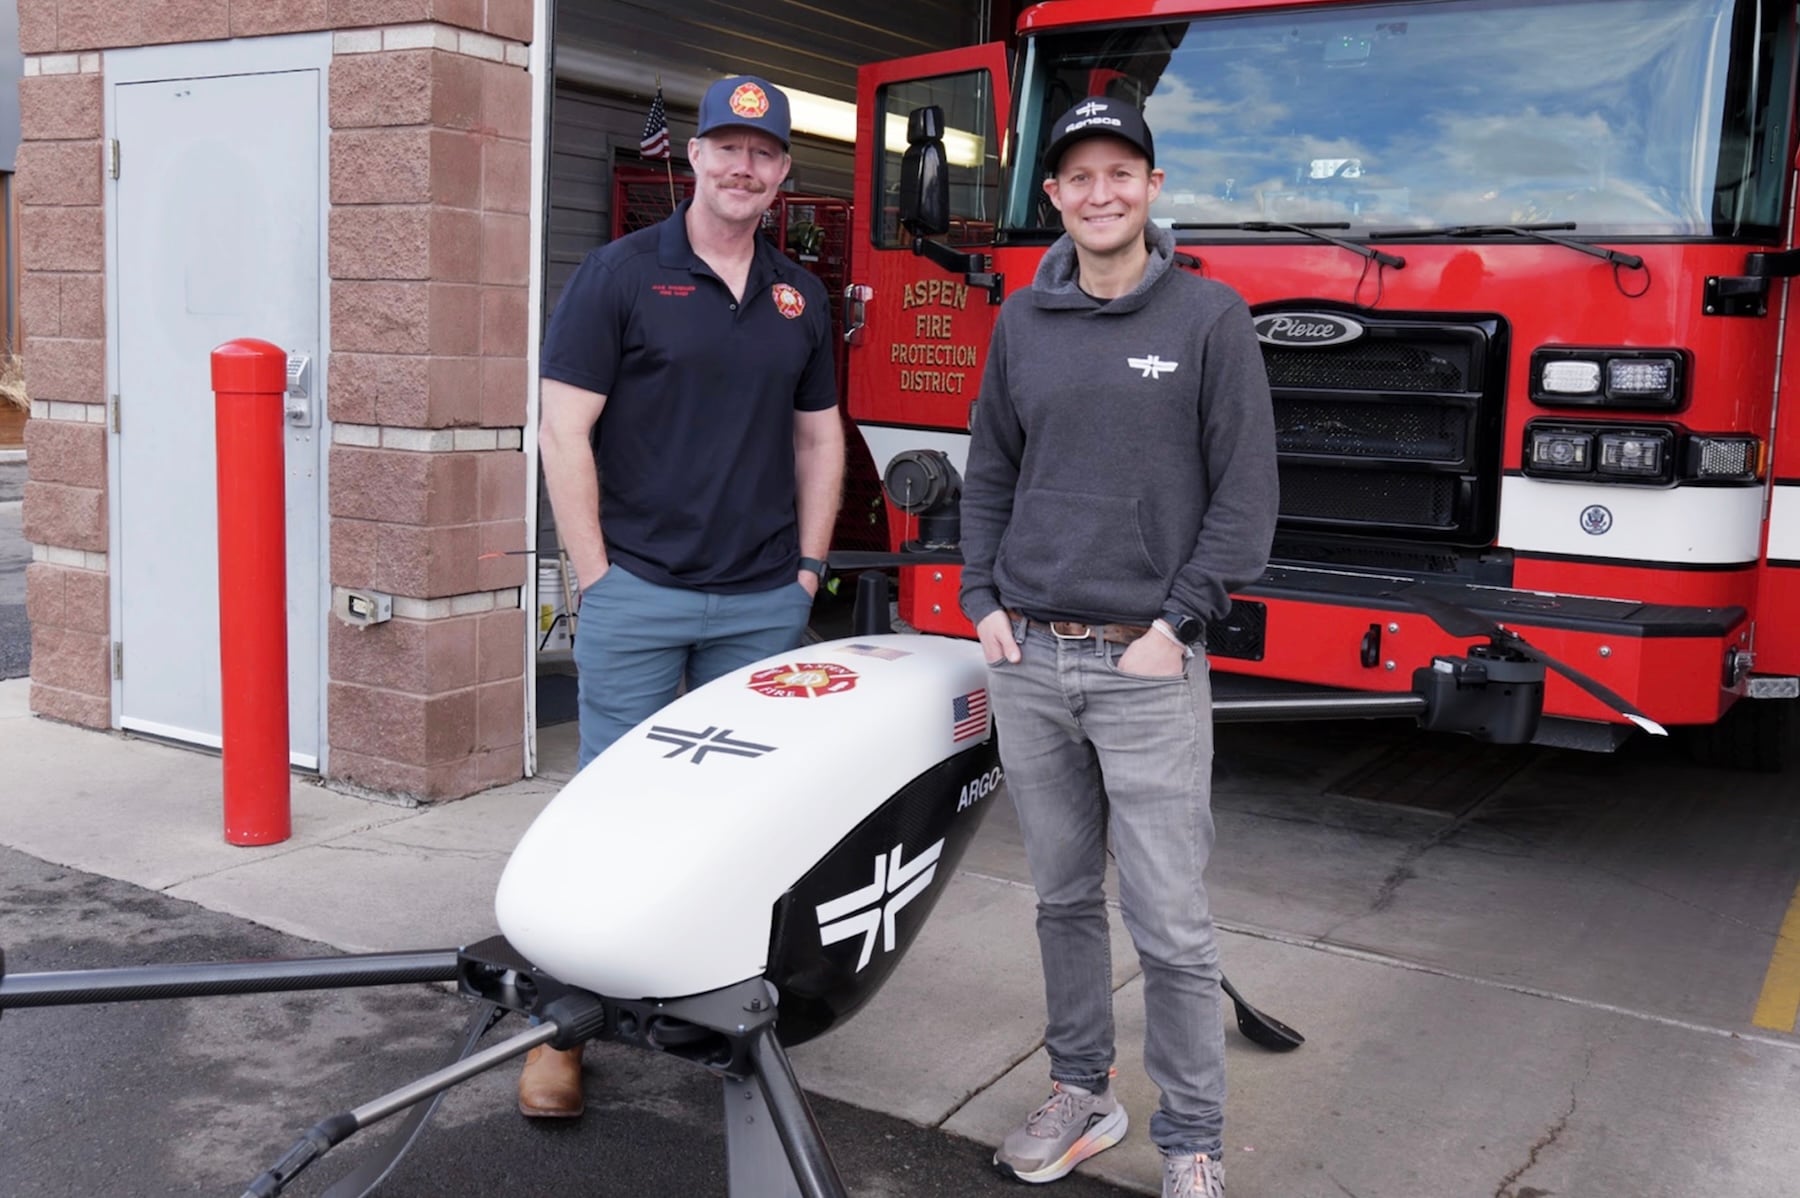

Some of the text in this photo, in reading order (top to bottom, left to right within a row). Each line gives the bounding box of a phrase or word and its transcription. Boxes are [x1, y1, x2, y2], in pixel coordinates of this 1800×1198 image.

[903, 280, 968, 310] ASPEN
[916, 315, 952, 338] FIRE
[1267, 317, 1335, 339] Pierce
[891, 343, 977, 367] PROTECTION
[900, 370, 965, 393] DISTRICT
[758, 686, 796, 697] FIRE
[957, 766, 1005, 813] ARGO-
